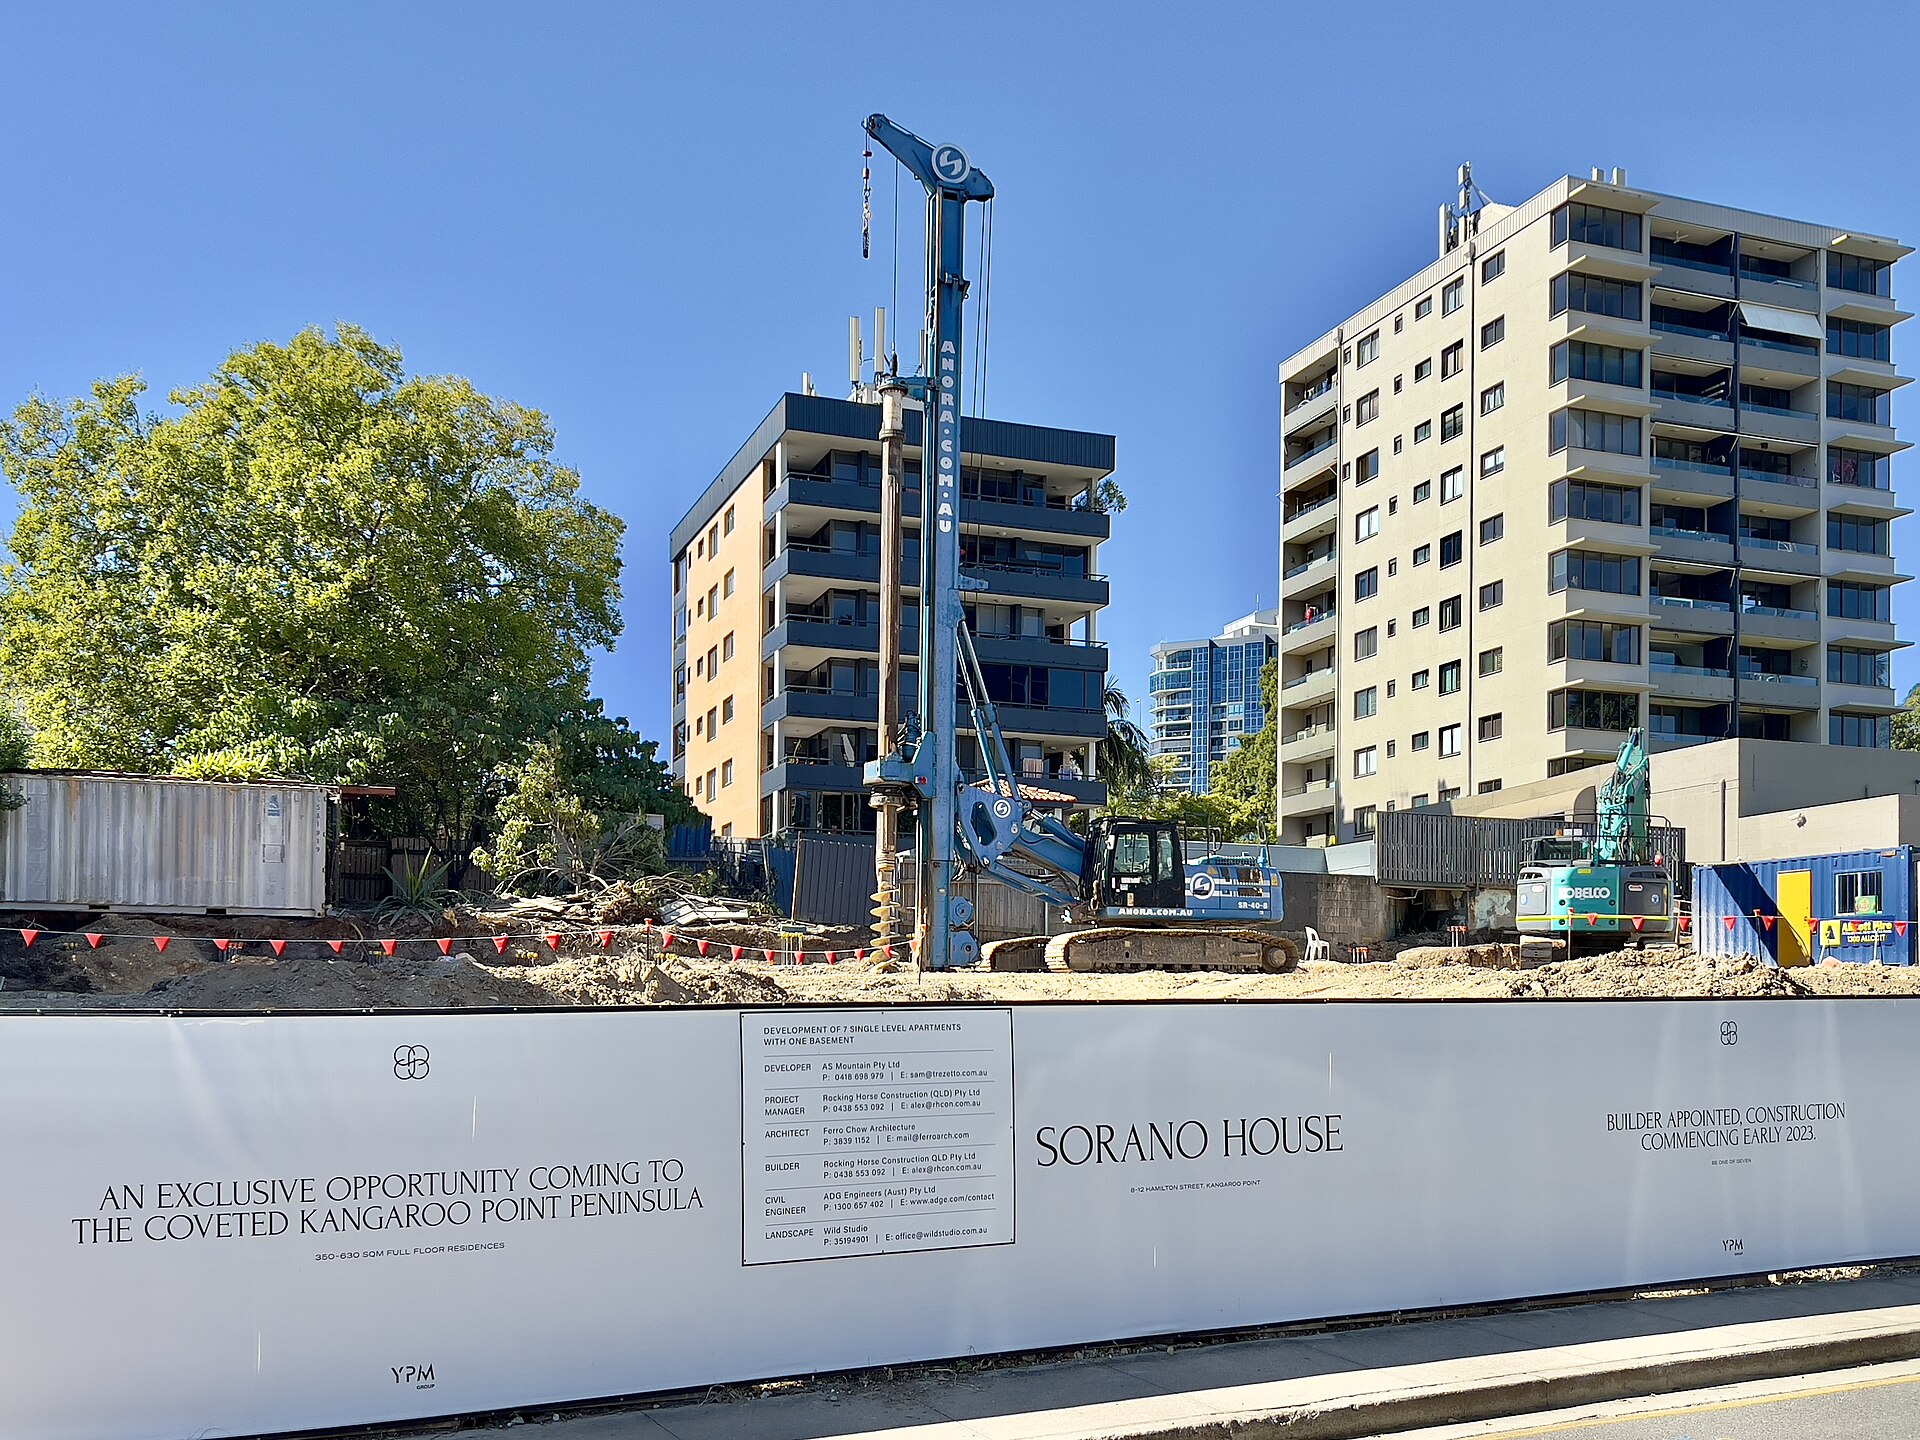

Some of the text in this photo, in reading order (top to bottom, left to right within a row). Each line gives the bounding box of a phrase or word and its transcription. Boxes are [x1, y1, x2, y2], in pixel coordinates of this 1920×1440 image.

[1558, 887, 1610, 899] KOBELCO
[1118, 908, 1193, 916] ANORA.COM.AU
[764, 1026, 827, 1035] DEVELOPMENT
[810, 1036, 854, 1044] BASEMENT
[765, 1064, 811, 1072] DEVELOPER
[873, 1061, 885, 1069] Pty
[765, 1096, 799, 1104] PROJECT
[823, 1094, 853, 1102] Rocking
[881, 1090, 928, 1099] Construction
[931, 1090, 952, 1098] (QLD)
[955, 1089, 966, 1097] Pty
[765, 1107, 805, 1116] MANAGER
[1607, 1103, 1846, 1131] BUILDER APPOINTED, CONSTRUCTION
[765, 1129, 809, 1138] ARCHITECT
[870, 1124, 915, 1132] Architecture
[834, 1137, 852, 1145] 3839
[855, 1136, 870, 1144] 1152
[897, 1132, 969, 1142] mail@ferroarch.com
[1036, 1115, 1344, 1167] SORANO HOUSE
[1642, 1125, 1816, 1150] COMMENCING EARLY 2023.
[766, 1162, 799, 1171] BUILDER
[824, 1160, 854, 1168] Rocking
[882, 1155, 929, 1165] Construction
[932, 1154, 947, 1162] QLD
[950, 1154, 962, 1162] Pty
[99, 1159, 684, 1211] AN EXCLUSIVE OPPORTUNITY COMING TO
[824, 1192, 841, 1200] ADG
[844, 1191, 882, 1199] Engineers
[884, 1187, 907, 1197] (Aust)
[910, 1186, 921, 1195] Pty
[765, 1196, 785, 1204] CIVIL
[870, 1200, 883, 1208] 402
[910, 1193, 994, 1205] www.adge.com/contact
[72, 1186, 703, 1244] THE COVETED KANGAROO POINT PENINSULA
[766, 1206, 805, 1216] ENGINEER
[766, 1229, 814, 1239] LANDSCAPE
[824, 1225, 868, 1235] Wild Studio
[834, 1236, 868, 1245] 35194901
[895, 1227, 987, 1240] office@wildstudio.com.au
[1722, 1239, 1743, 1251] YPM
[315, 1252, 359, 1261] 350-630
[387, 1248, 410, 1256] FULL
[413, 1246, 444, 1254] FLOOR
[448, 1242, 505, 1252] RESIDENCES
[391, 1364, 434, 1383] YPM
